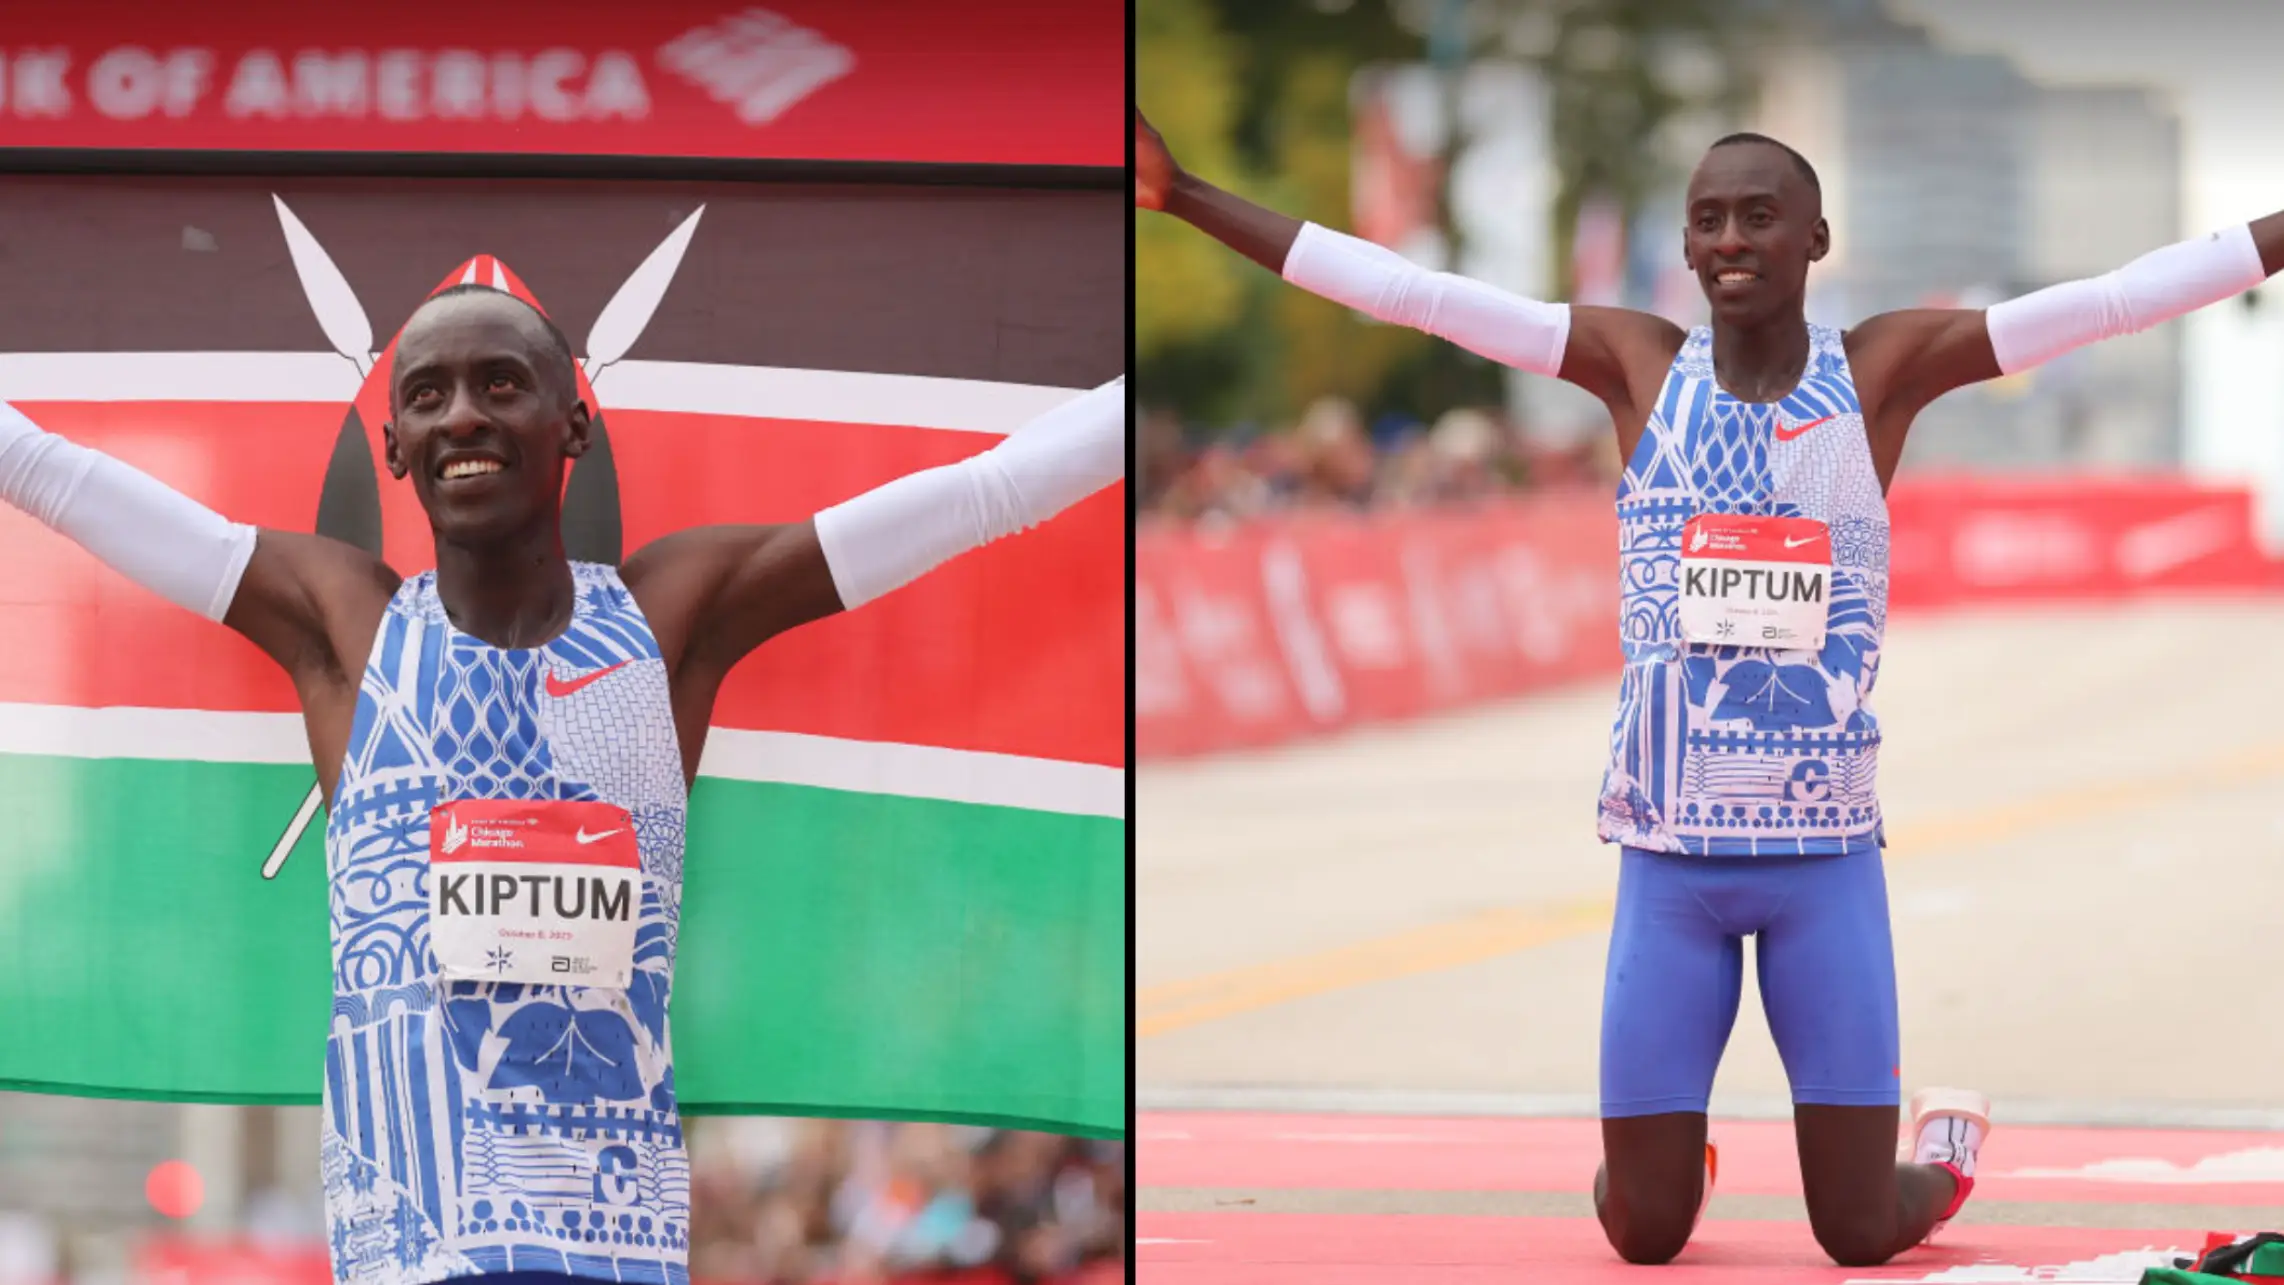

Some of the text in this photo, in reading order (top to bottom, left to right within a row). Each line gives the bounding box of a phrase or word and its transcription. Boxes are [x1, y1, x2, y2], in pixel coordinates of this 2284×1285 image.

[0, 46, 651, 121] K OF AMERICA
[1685, 567, 1823, 603] KIPTUM
[471, 826, 514, 840] Chicago
[471, 837, 525, 848] Marathon
[439, 873, 631, 921] KIPTUM
